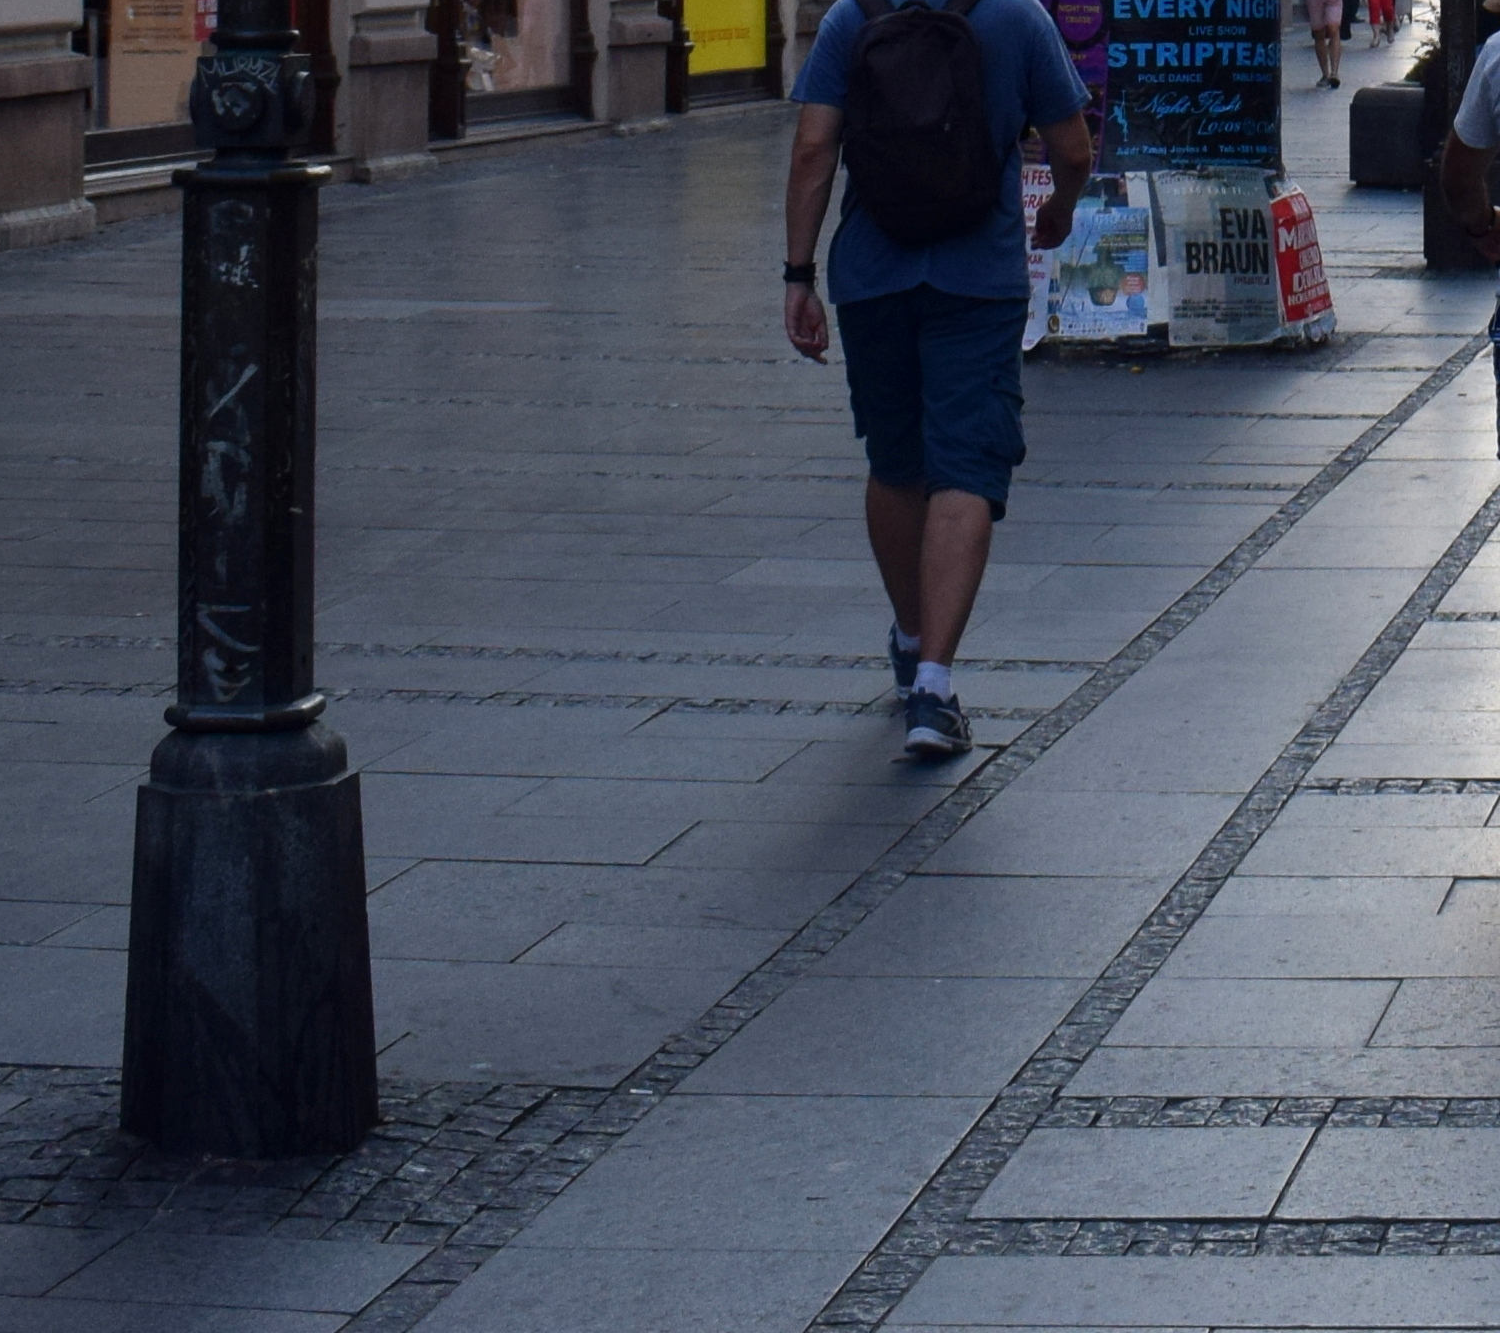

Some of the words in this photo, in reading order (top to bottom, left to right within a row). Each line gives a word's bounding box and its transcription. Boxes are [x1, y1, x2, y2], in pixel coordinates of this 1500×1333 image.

[1188, 25, 1214, 37] LIVE
[1216, 25, 1248, 37] SHOW
[1137, 73, 1165, 84] POLE
[1168, 73, 1204, 84] DANCE
[1220, 208, 1269, 240] EVA
[1185, 241, 1269, 275] BRAUN
